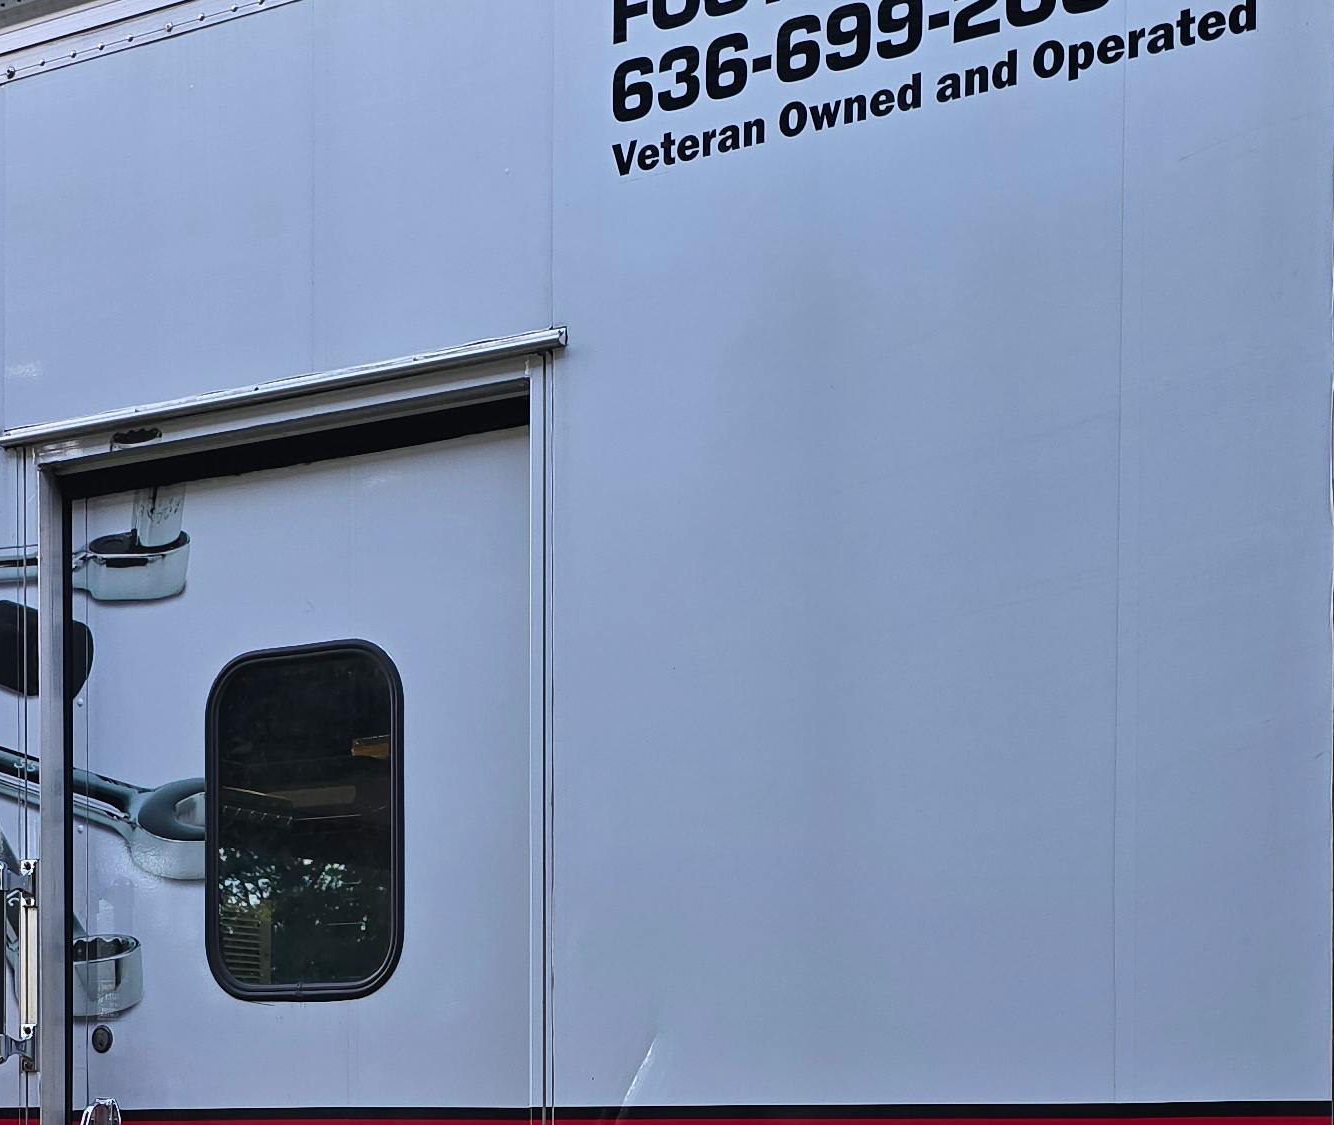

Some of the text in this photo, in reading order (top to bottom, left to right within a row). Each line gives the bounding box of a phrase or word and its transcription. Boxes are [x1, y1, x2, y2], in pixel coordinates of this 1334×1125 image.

[612, 0, 1108, 122] 636-699-2
[612, 0, 1257, 176] Veteran Owned and Operated
